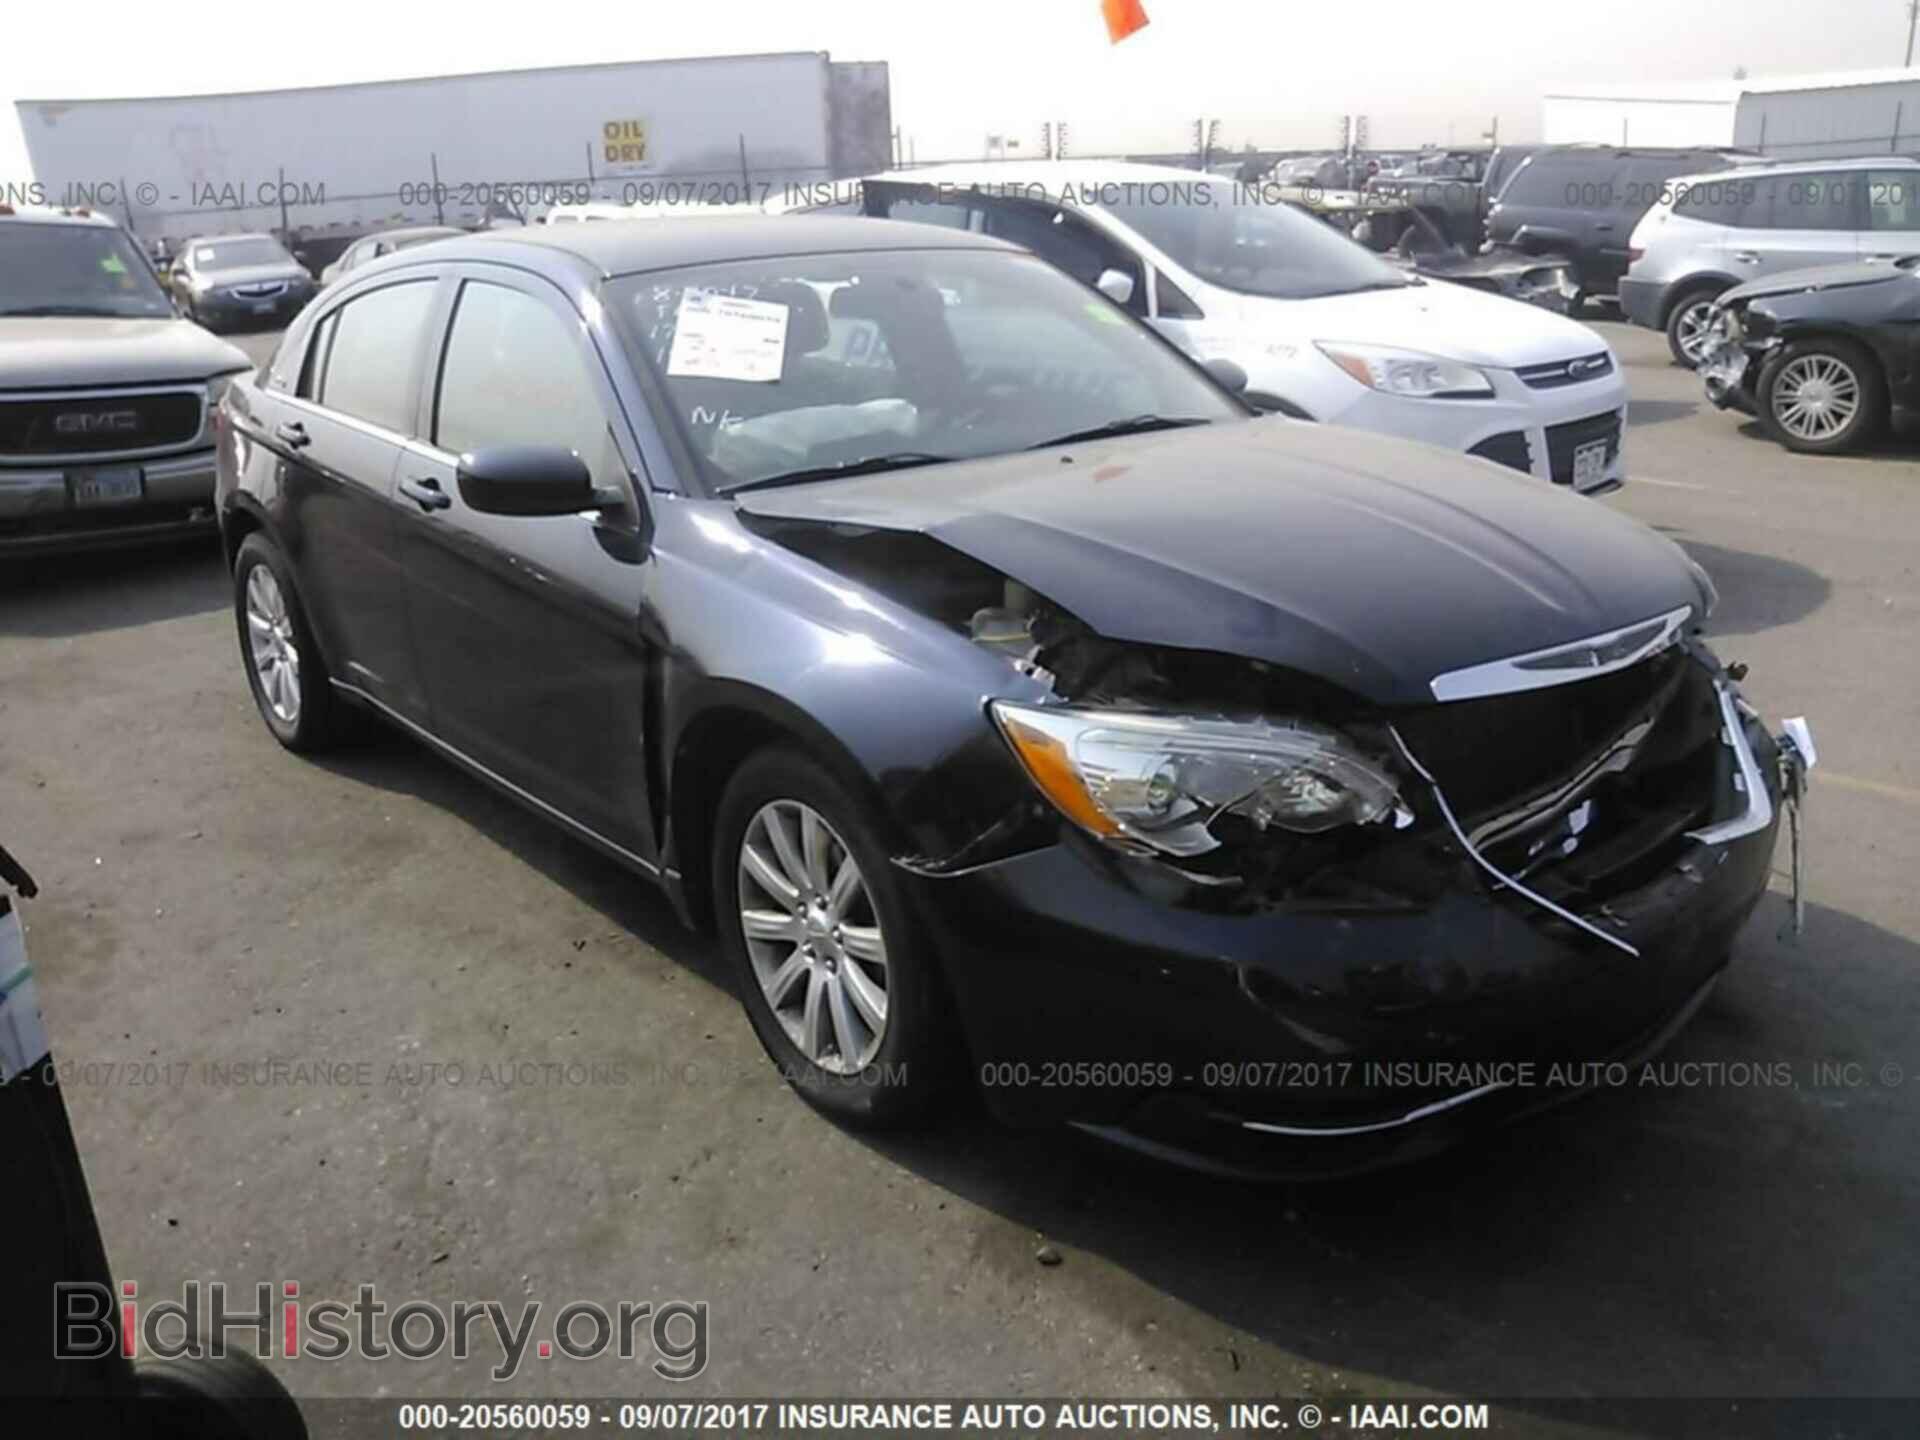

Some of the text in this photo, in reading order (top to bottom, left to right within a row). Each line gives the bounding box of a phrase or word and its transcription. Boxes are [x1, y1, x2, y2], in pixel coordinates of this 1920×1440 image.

[603, 120, 643, 139] OIL
[605, 144, 645, 161] DRY
[56, 411, 137, 432] GMC
